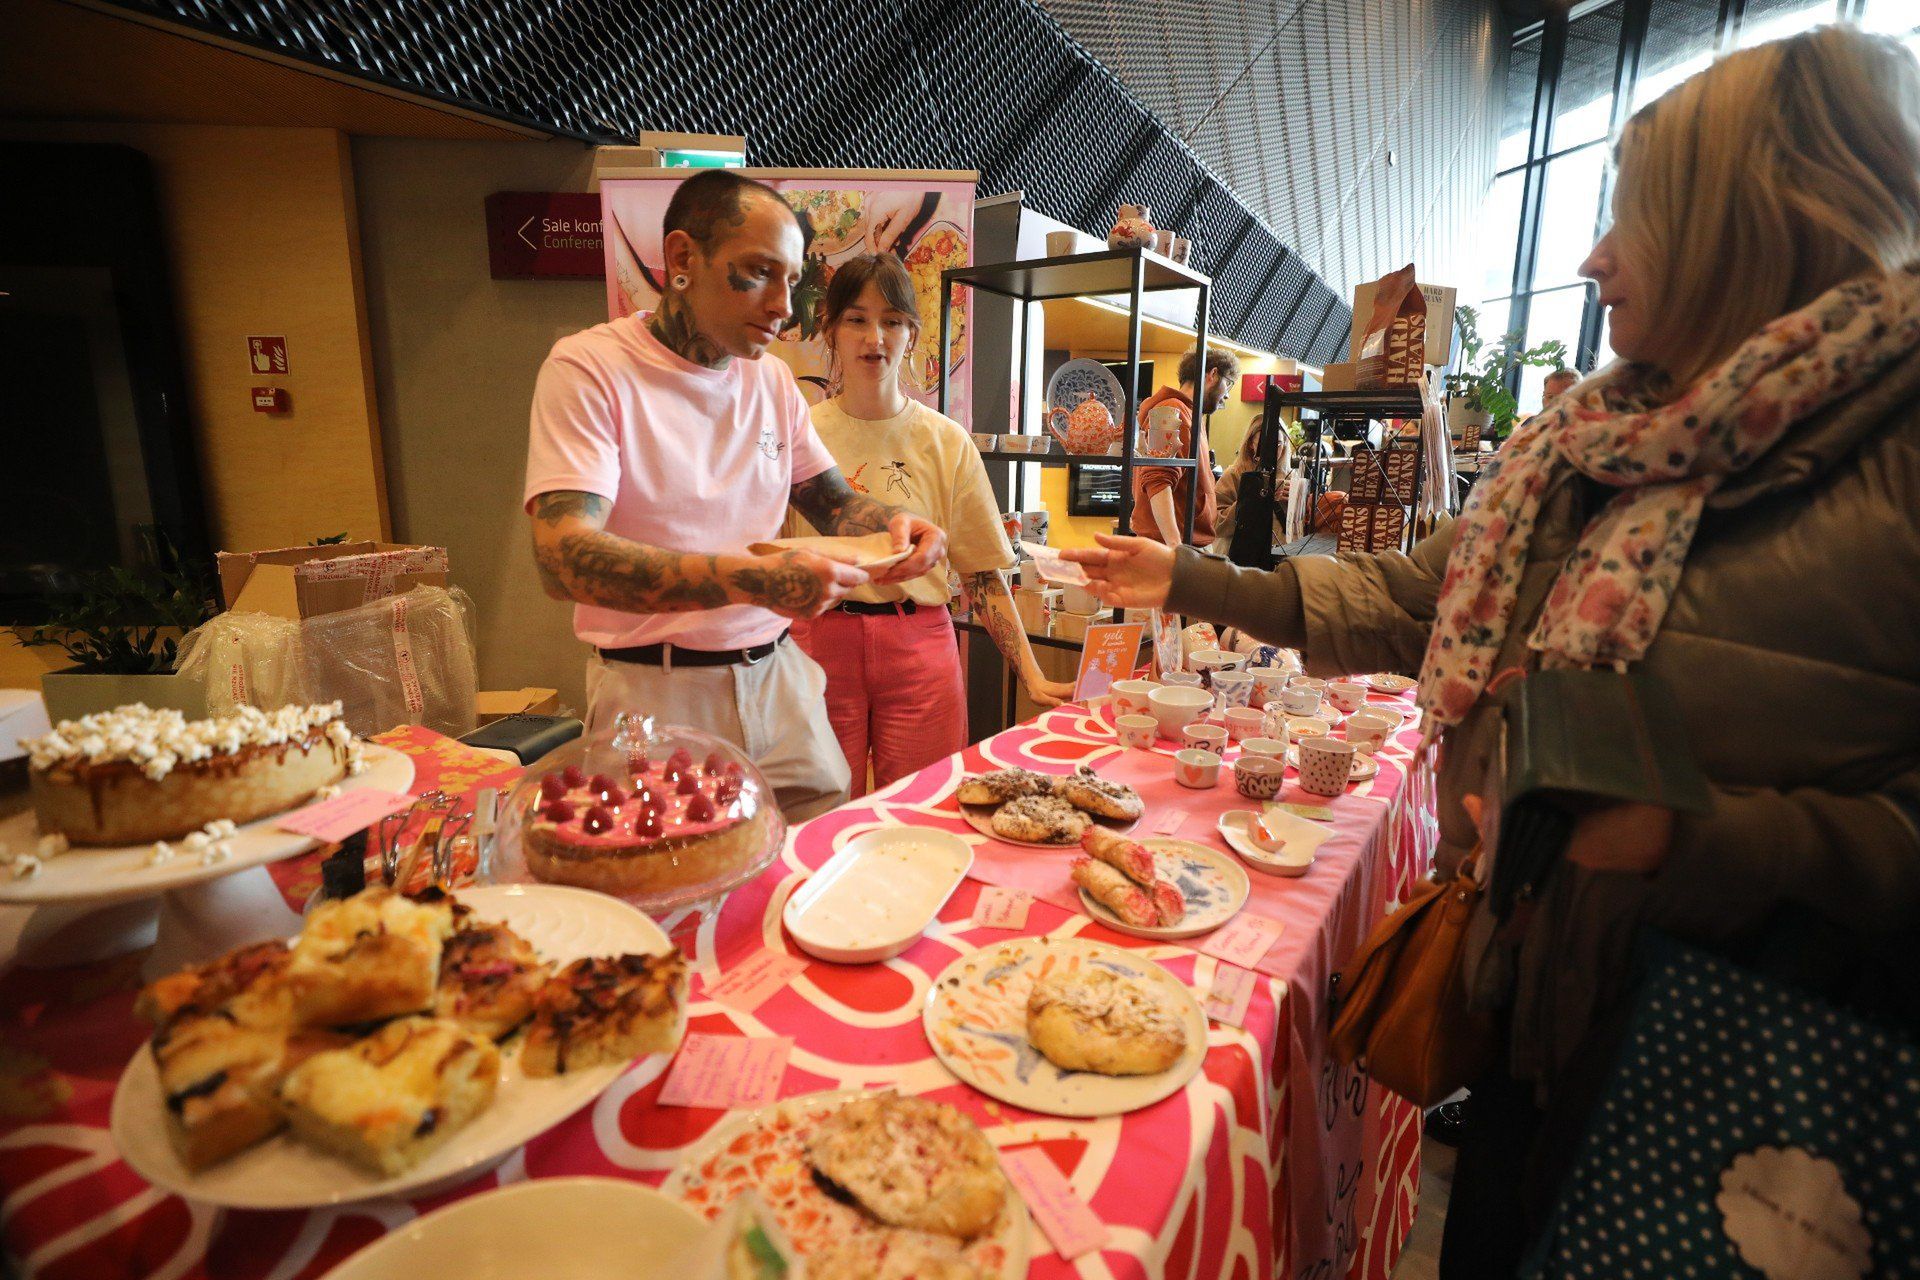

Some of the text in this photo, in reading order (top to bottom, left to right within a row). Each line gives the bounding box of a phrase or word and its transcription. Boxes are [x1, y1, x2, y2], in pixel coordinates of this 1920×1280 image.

[542, 218, 570, 232] Sale
[544, 235, 603, 249] Conferen
[1424, 286, 1443, 296] HARD
[1386, 317, 1409, 383] HARD
[1406, 314, 1426, 383] BEANS
[1352, 452, 1368, 498] HARD
[1384, 453, 1401, 498] HARD
[1399, 453, 1415, 498] BEANS
[1339, 506, 1355, 551] HARD
[1353, 507, 1369, 551] BEANS
[1372, 507, 1388, 552] HARD
